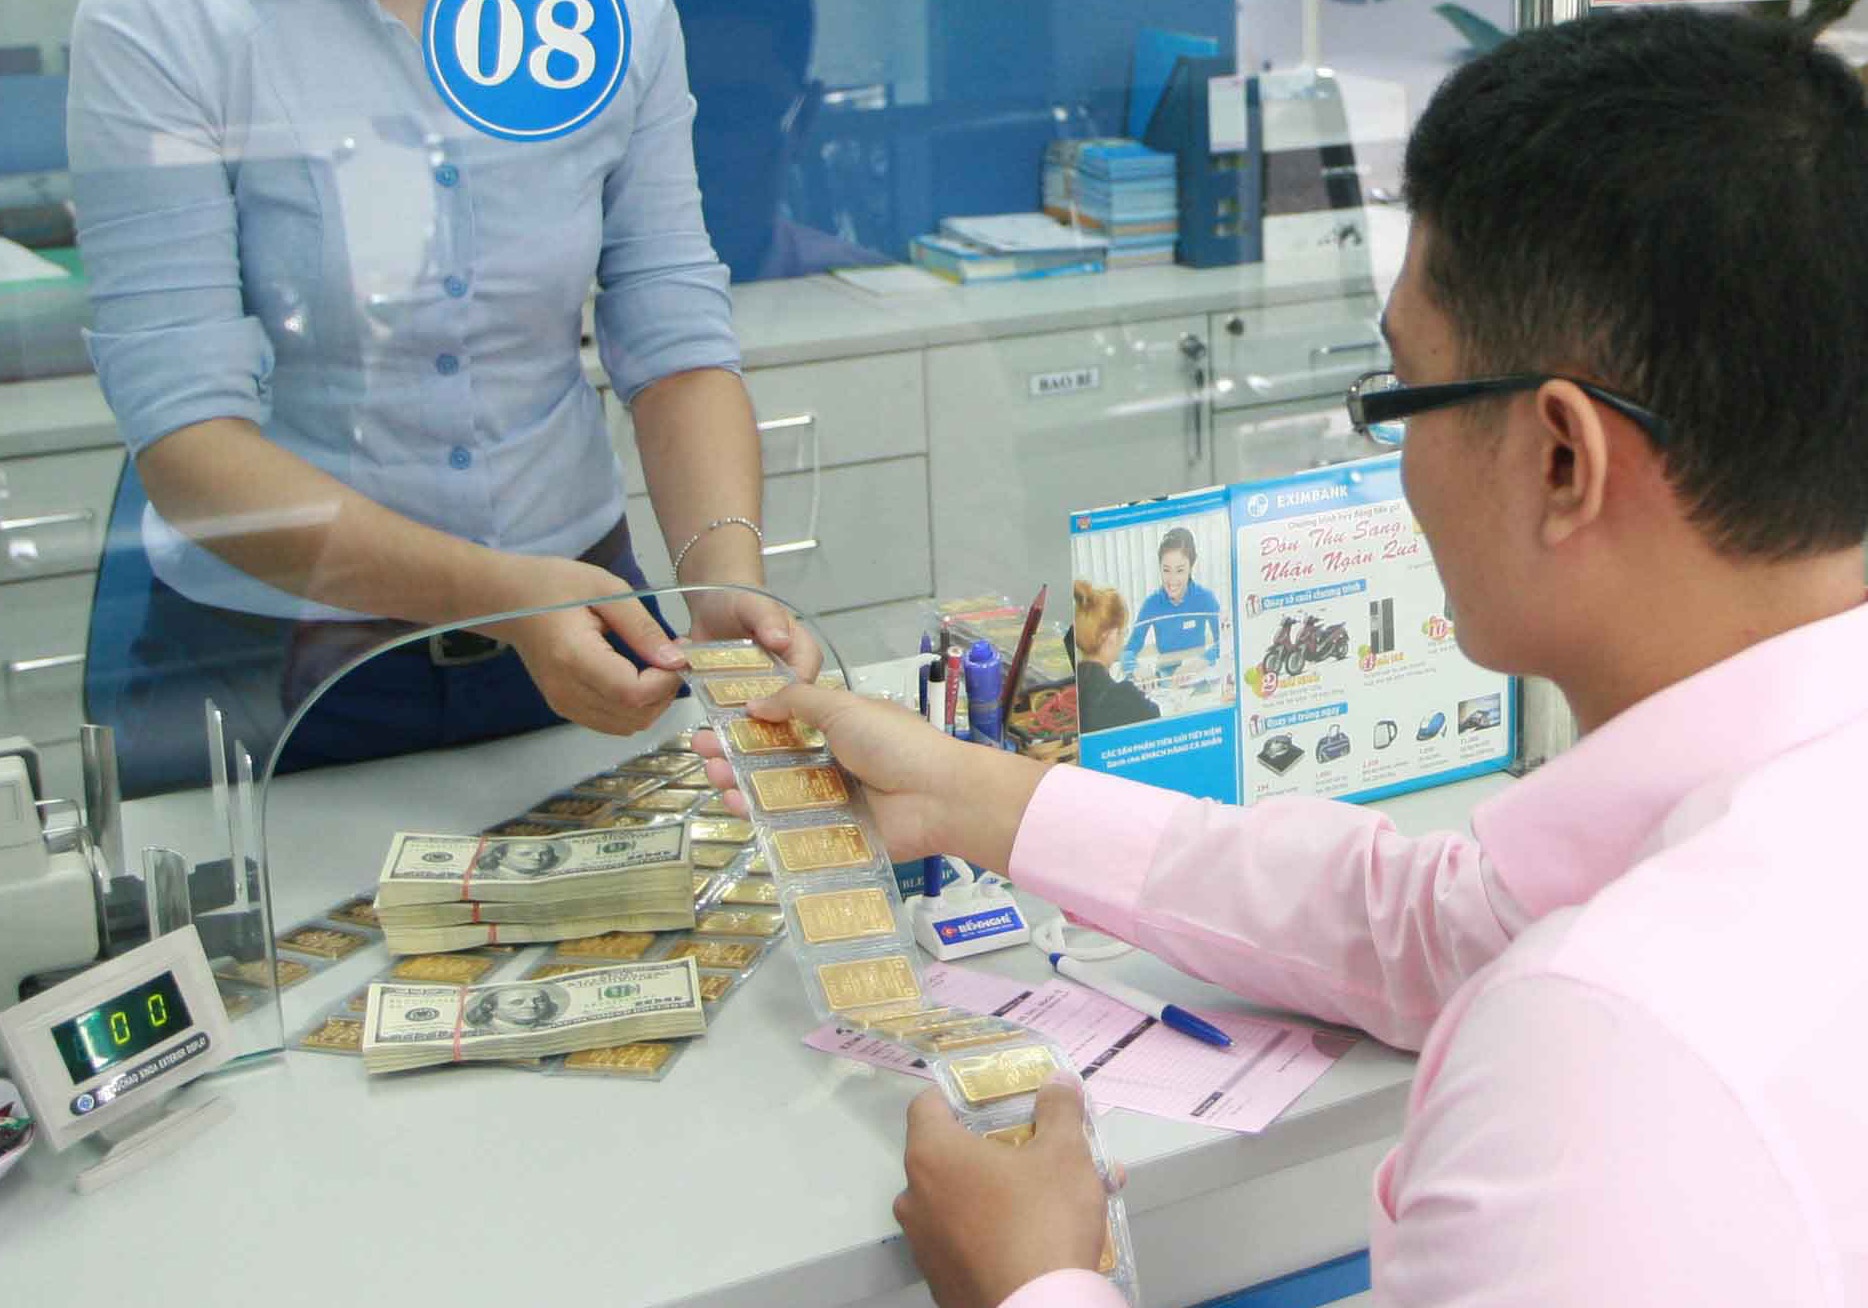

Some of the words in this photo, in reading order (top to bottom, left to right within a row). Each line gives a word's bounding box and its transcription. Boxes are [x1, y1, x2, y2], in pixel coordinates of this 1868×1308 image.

[455, 0, 596, 90] 08
[1277, 485, 1348, 507] EXIMBANK
[1309, 527, 1347, 548] Thu
[1260, 559, 1315, 582] Nhận
